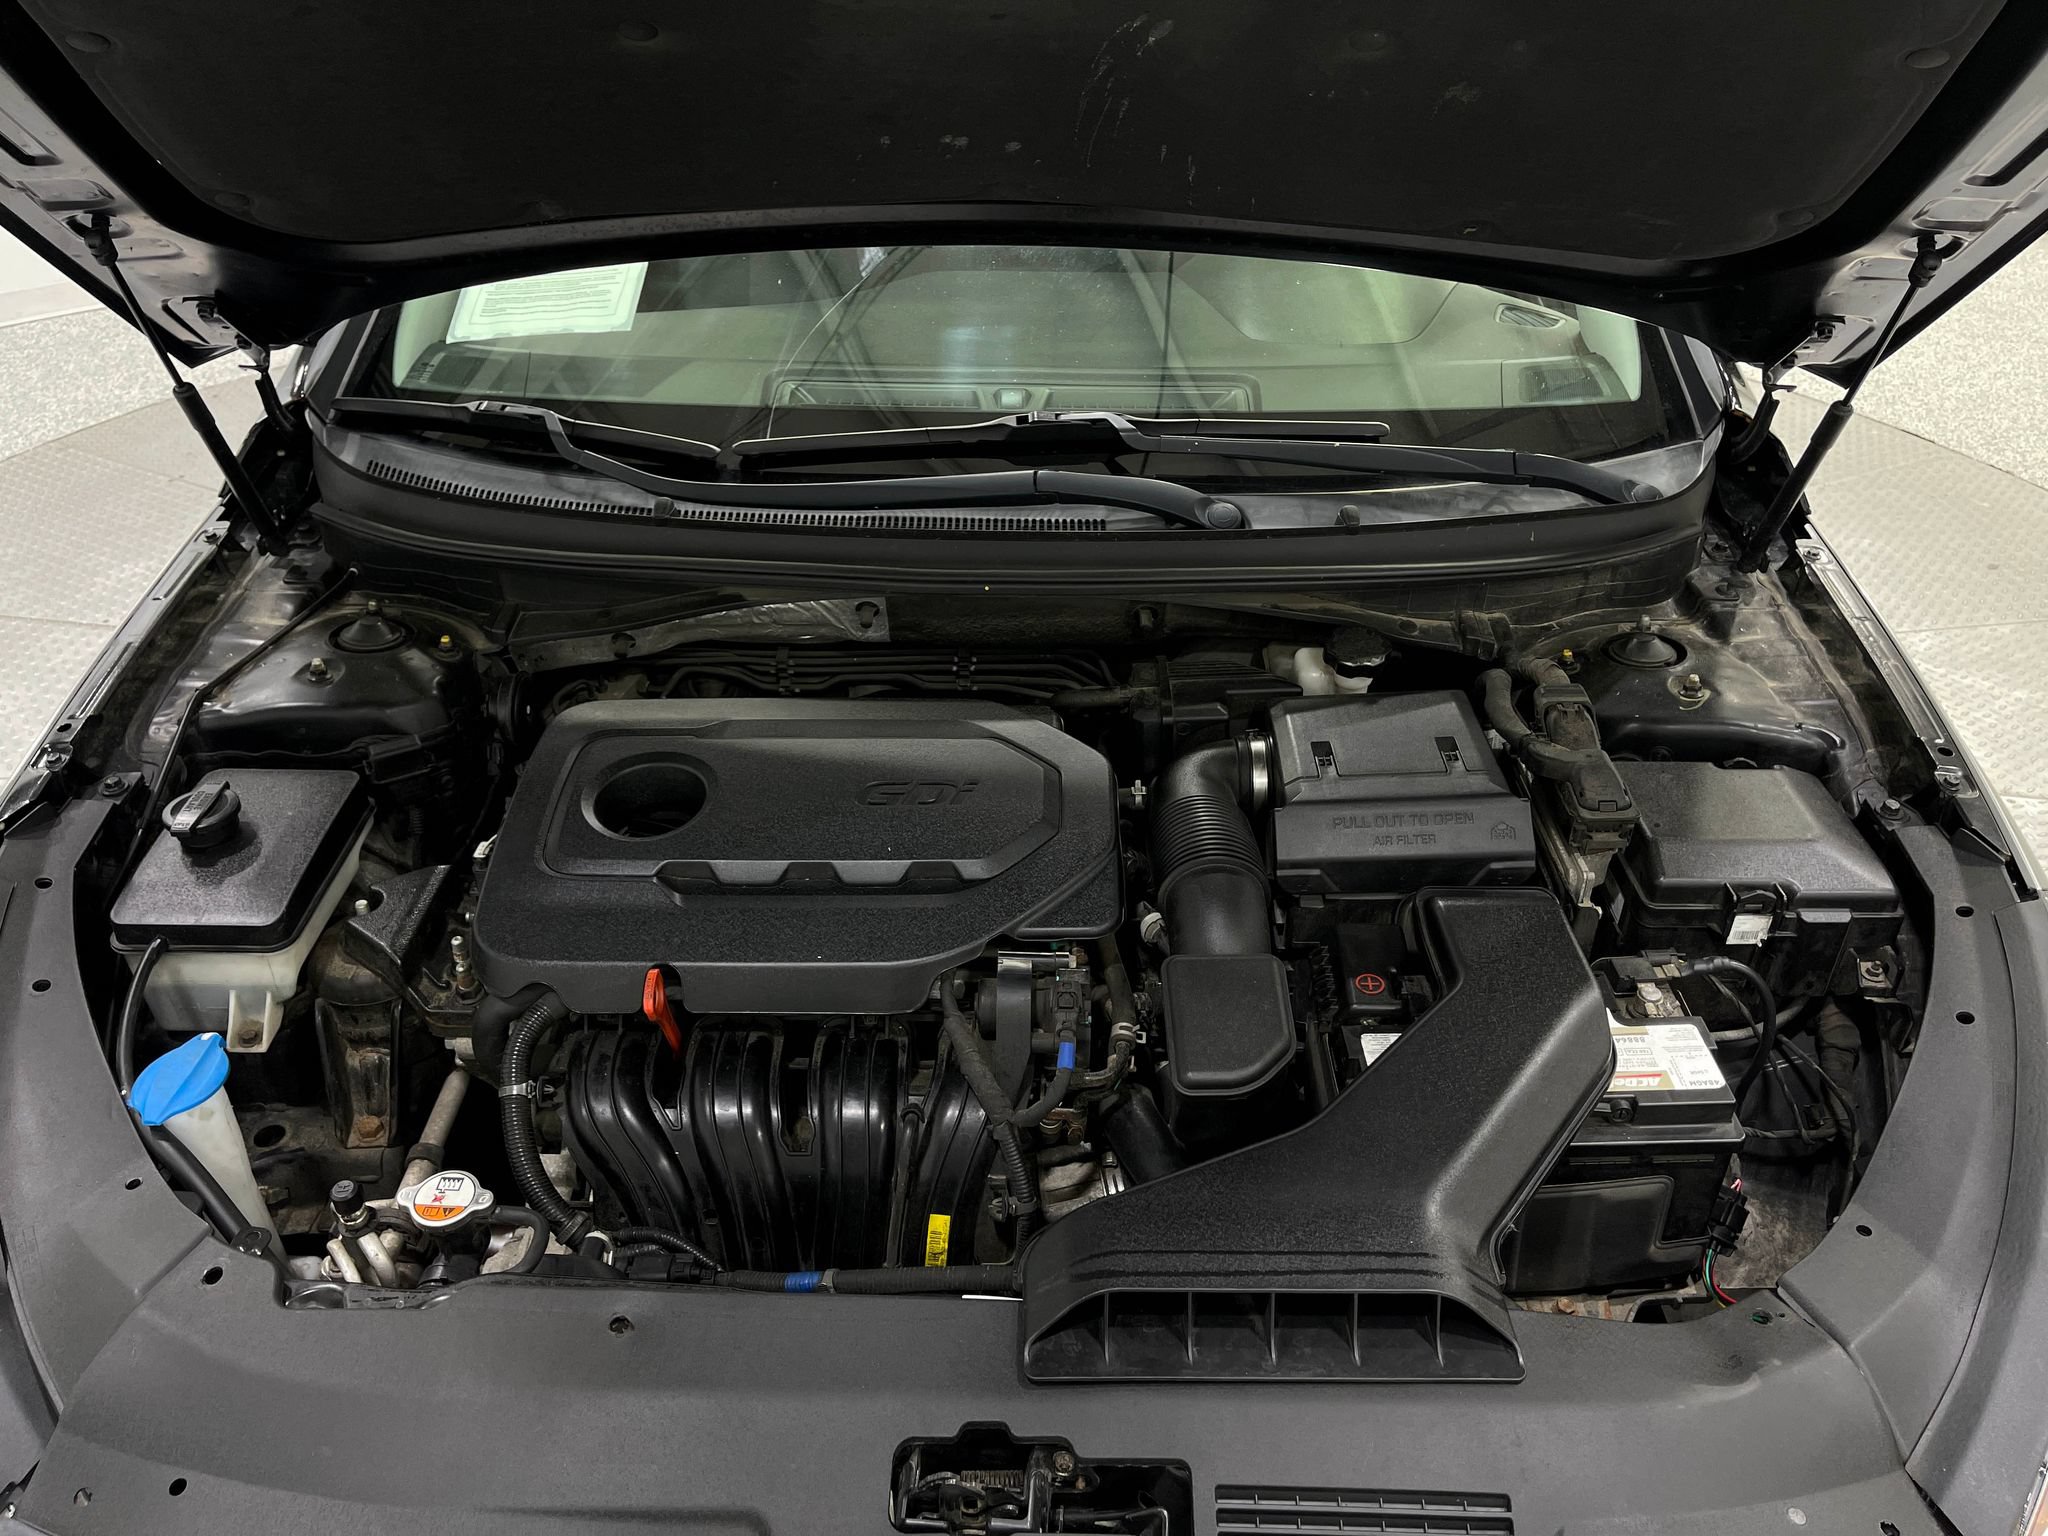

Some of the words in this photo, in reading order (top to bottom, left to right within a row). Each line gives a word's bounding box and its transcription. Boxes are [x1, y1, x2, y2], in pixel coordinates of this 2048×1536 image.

[1332, 815, 1371, 829] PULL
[1374, 813, 1405, 828] OUT
[1408, 813, 1429, 827] TO
[1432, 811, 1475, 826] OPEN
[1373, 835, 1393, 847] AIR
[1396, 833, 1437, 846] FILTER
